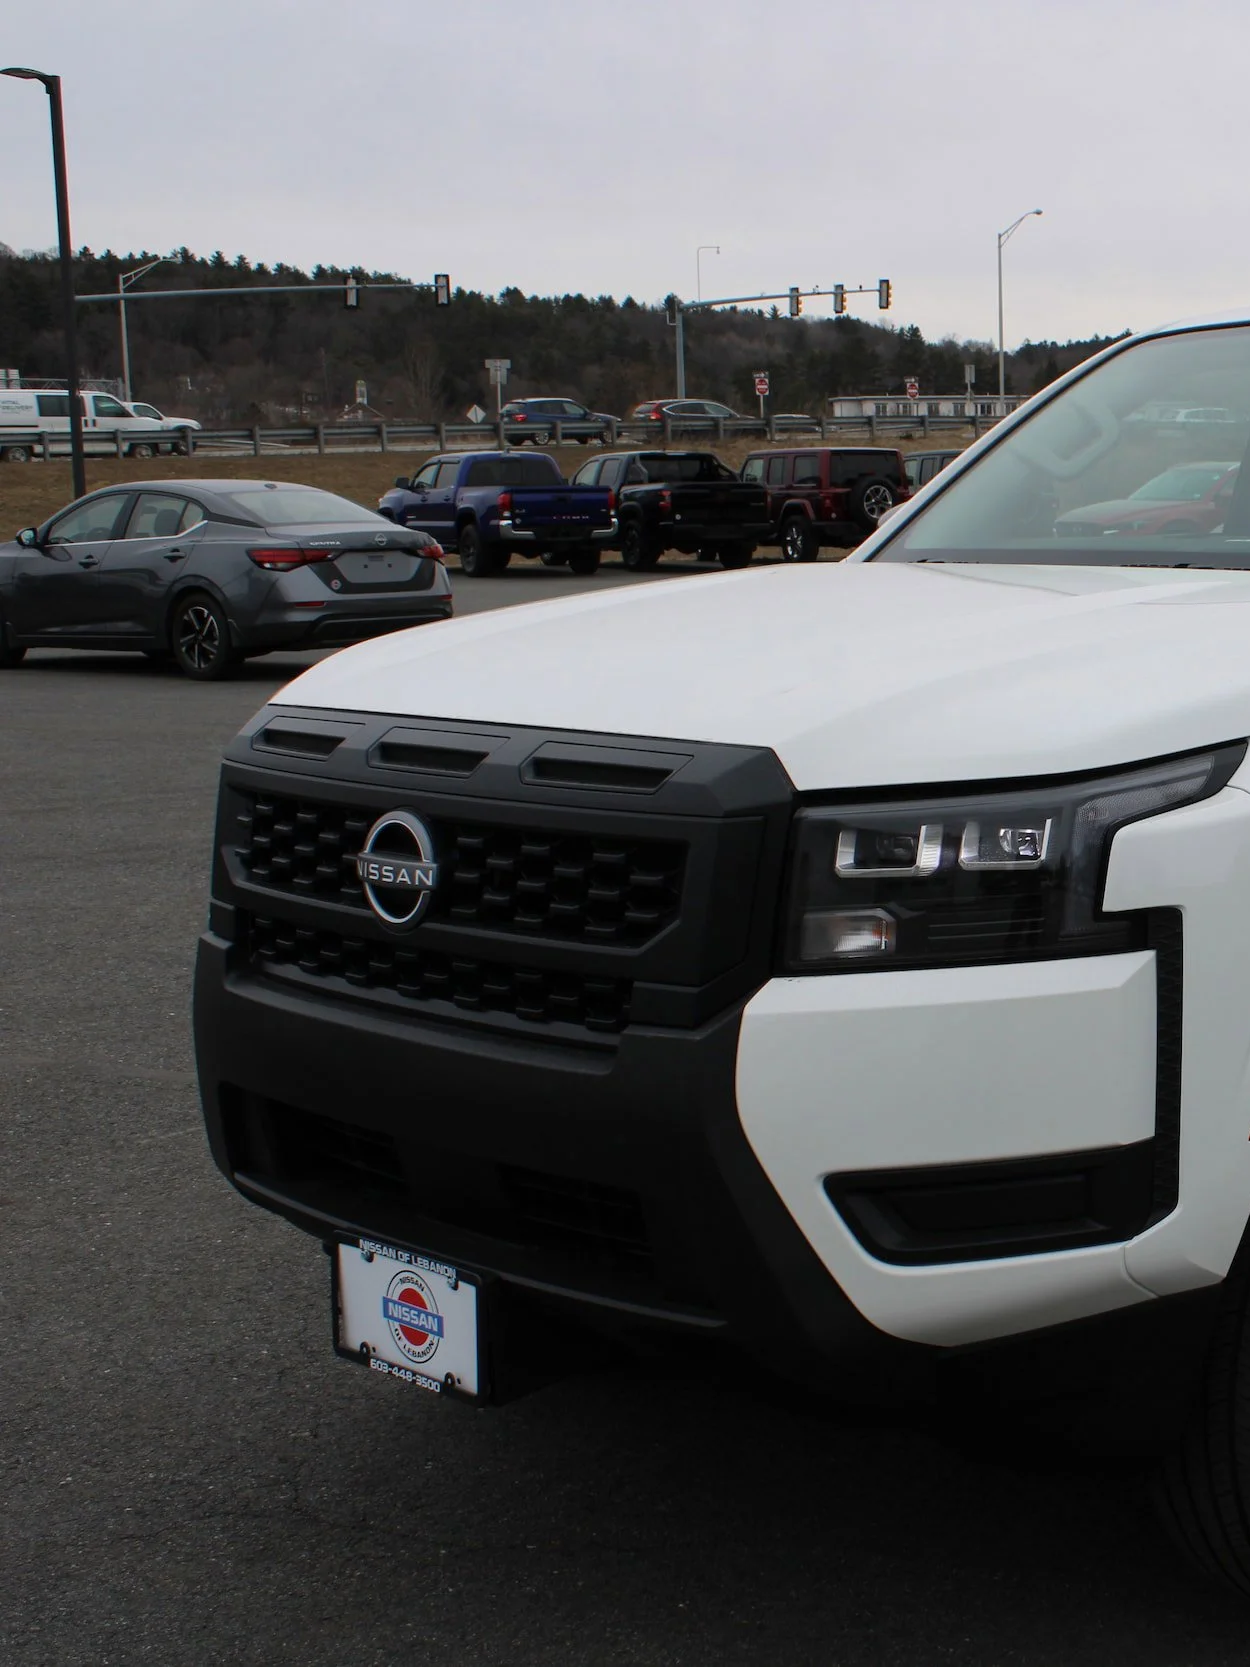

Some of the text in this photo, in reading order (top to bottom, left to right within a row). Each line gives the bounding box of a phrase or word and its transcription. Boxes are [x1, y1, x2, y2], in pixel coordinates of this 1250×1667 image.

[358, 861, 433, 886] NISSAN
[359, 1239, 457, 1279] NISSAN OF LEBANON
[399, 1275, 425, 1292] NISSAN
[388, 1302, 438, 1332] NISSAN
[403, 1340, 435, 1358] LEBANON
[370, 1358, 441, 1393] 603-448-3500
